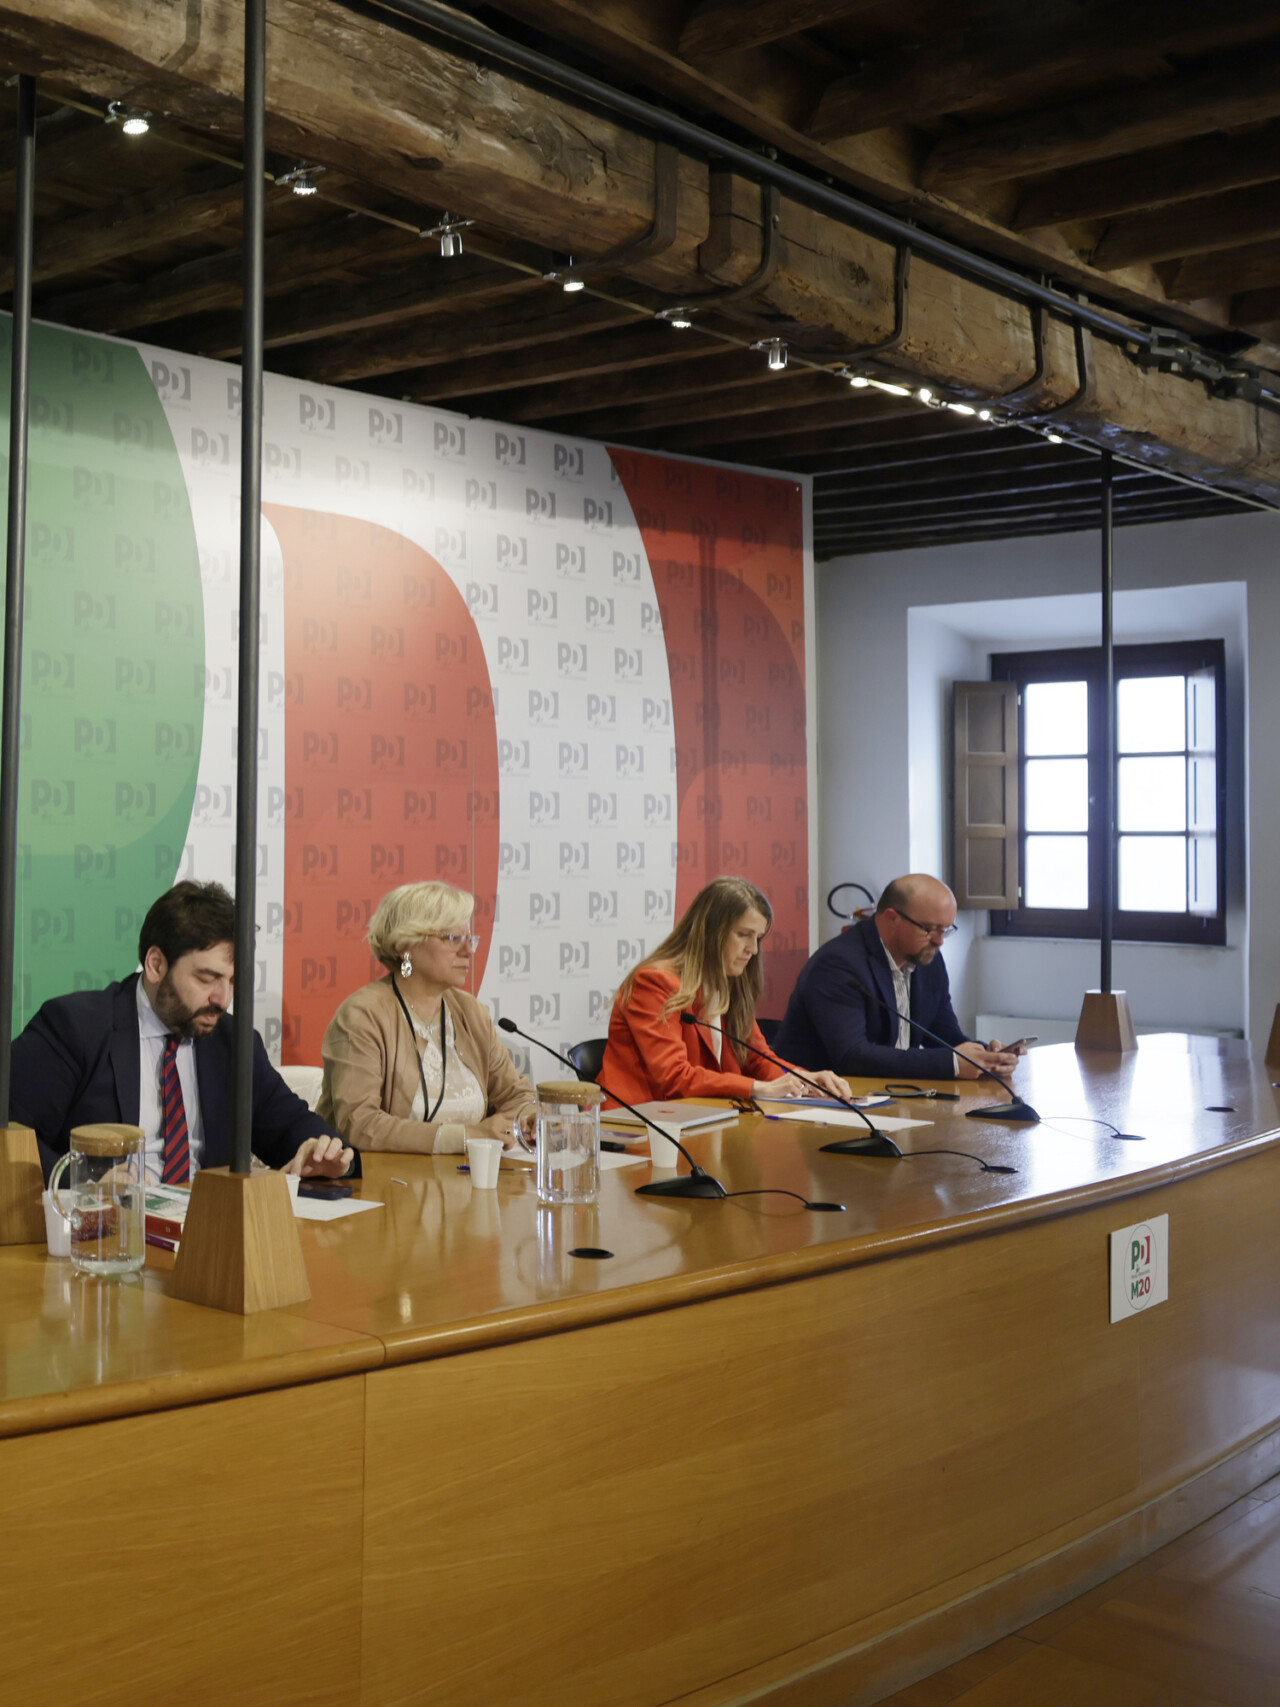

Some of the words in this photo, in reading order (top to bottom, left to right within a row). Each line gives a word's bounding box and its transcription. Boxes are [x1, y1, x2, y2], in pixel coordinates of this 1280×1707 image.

[433, 421, 464, 456] PD
[495, 433, 525, 466] PD
[555, 443, 582, 476] PD
[465, 478, 496, 512] PD
[526, 488, 555, 520] PD
[584, 497, 611, 529] PD
[497, 534, 526, 566] PD
[556, 542, 584, 573] PD
[613, 550, 639, 580] PD
[467, 581, 497, 613] PD
[528, 588, 556, 620] PD
[586, 595, 613, 625] PD
[436, 630, 467, 662] PD
[498, 636, 528, 667] PD
[558, 641, 586, 672] PD
[615, 646, 641, 676] PD
[468, 685, 498, 716] PD
[529, 689, 558, 720] PD
[587, 693, 614, 722] PD
[437, 736, 468, 767] PD
[499, 739, 529, 769] PD
[559, 741, 587, 770] PD
[616, 744, 642, 772] PD
[468, 790, 499, 820] PD
[530, 791, 559, 820] PD
[588, 792, 615, 820] PD
[437, 843, 468, 872] PD
[500, 842, 529, 871] PD
[560, 842, 588, 869] PD
[617, 841, 643, 868] PD
[530, 893, 559, 921] PD
[589, 891, 616, 918] PD
[499, 944, 529, 974] PD
[560, 941, 588, 969] PD
[530, 992, 559, 1022] PD
[1131, 1235, 1151, 1270] PD
[1131, 1276, 1151, 1300] M20
